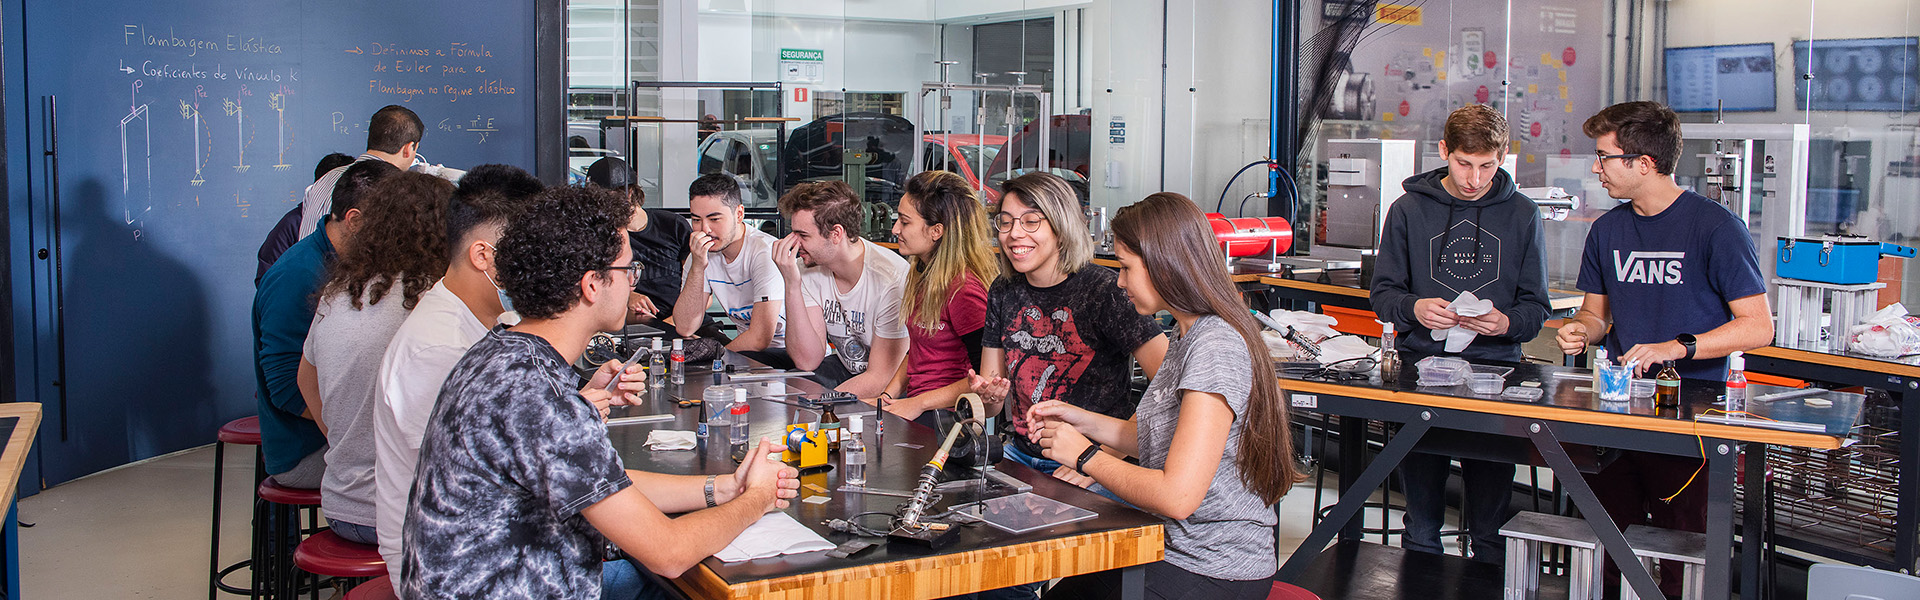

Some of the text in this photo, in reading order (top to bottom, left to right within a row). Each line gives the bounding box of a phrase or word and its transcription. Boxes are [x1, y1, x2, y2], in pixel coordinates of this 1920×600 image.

[124, 23, 283, 57] Flambagem Elástica
[436, 49, 446, 57] a
[782, 50, 822, 60] SEGURANÇA
[142, 60, 207, 79] Coeficientes
[214, 63, 228, 80] de
[374, 60, 486, 77] de Euler para a
[369, 80, 425, 102] Flambagem
[429, 87, 439, 95] no
[478, 79, 516, 95] elástico
